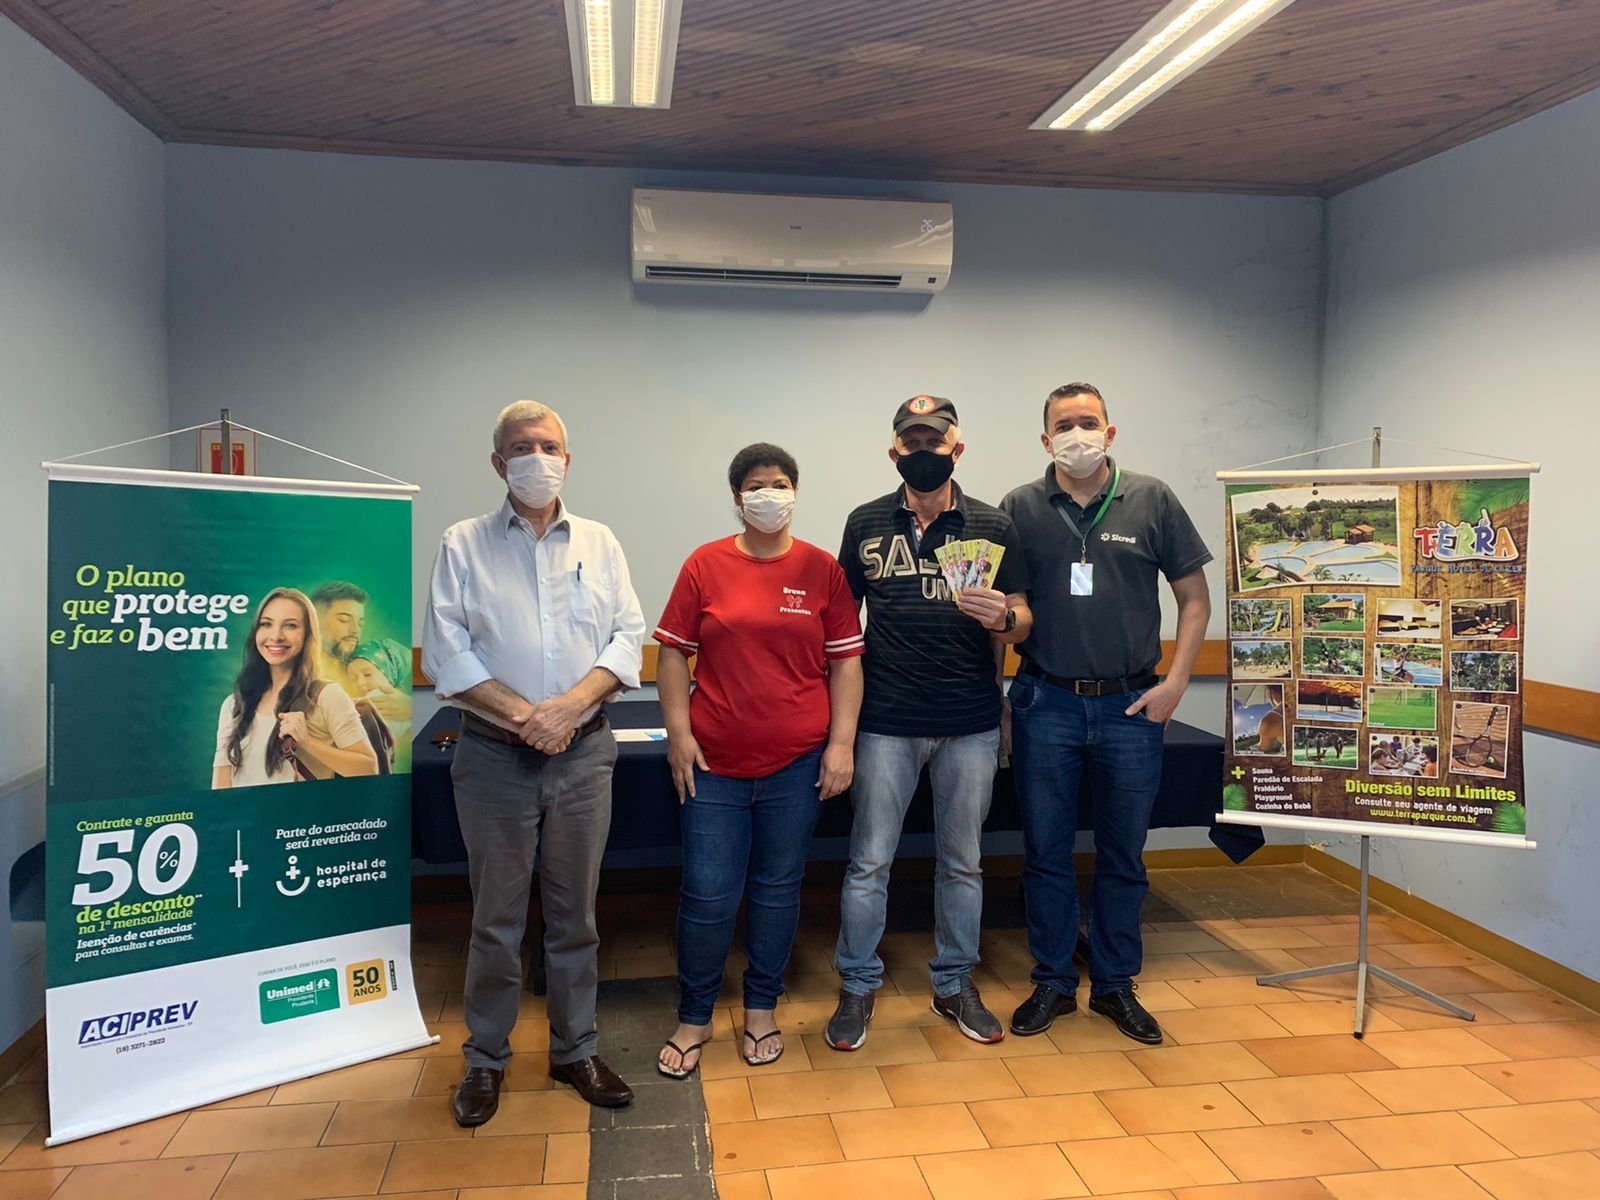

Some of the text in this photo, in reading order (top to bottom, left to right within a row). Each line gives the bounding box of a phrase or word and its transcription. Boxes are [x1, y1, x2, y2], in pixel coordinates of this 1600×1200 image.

[1111, 533, 1136, 544] Sicredi
[1413, 514, 1519, 561] TERRA
[76, 564, 185, 593] O plano
[62, 589, 249, 624] que protege
[50, 617, 228, 651] e faz o bem
[1252, 767, 1273, 775] Sauna
[1253, 776, 1281, 784] Paredão
[1292, 775, 1323, 783] Escalada
[1254, 785, 1284, 793] Fraldário
[1254, 794, 1293, 802] Playground
[1345, 779, 1517, 802] Diversão sem Limites
[1255, 801, 1311, 810] Cozinha do Bebê
[1355, 796, 1493, 815] Consulte seu agente de viagem
[76, 811, 194, 832] Contrate e garanta
[1370, 808, 1477, 824] www.terraparque.com.br
[275, 818, 387, 840] Parte do arrecadado
[285, 831, 378, 850] será revertida ao
[316, 858, 387, 876] hospital de
[316, 870, 387, 888] esperança
[76, 905, 102, 923] de
[78, 908, 193, 935] na 1ª mensalidade
[75, 949, 99, 962] para
[100, 941, 147, 956] consultas
[156, 934, 194, 946] exames.
[77, 934, 122, 949] Isenção
[123, 930, 138, 942] de
[353, 966, 380, 988] 50
[266, 981, 314, 1000] Unimed
[353, 984, 381, 997] ANOS
[79, 1000, 199, 1044] ACIPREV
